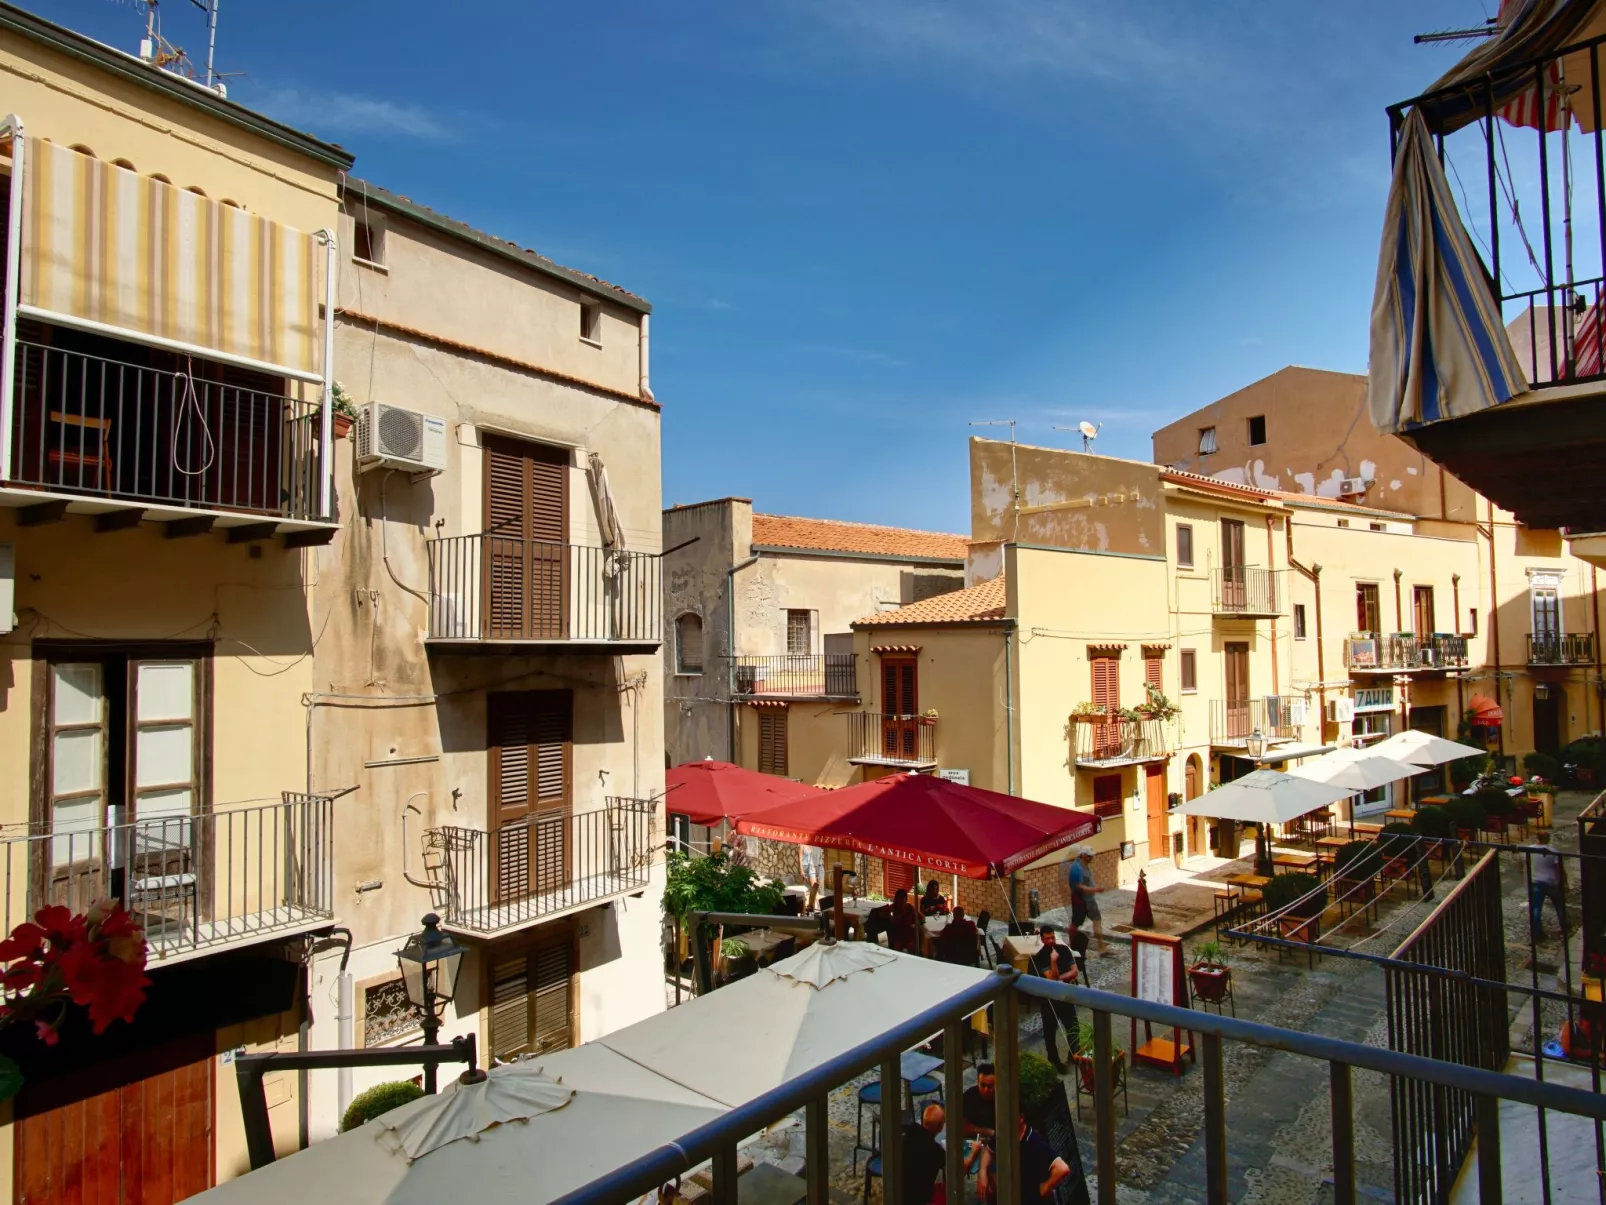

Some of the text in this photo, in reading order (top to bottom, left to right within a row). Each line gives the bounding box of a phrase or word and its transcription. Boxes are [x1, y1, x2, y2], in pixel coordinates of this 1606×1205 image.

[1356, 689, 1392, 707] ZAHIR
[750, 825, 967, 872] RISTORANTE PIZZERIA L'ANTICA CORTE
